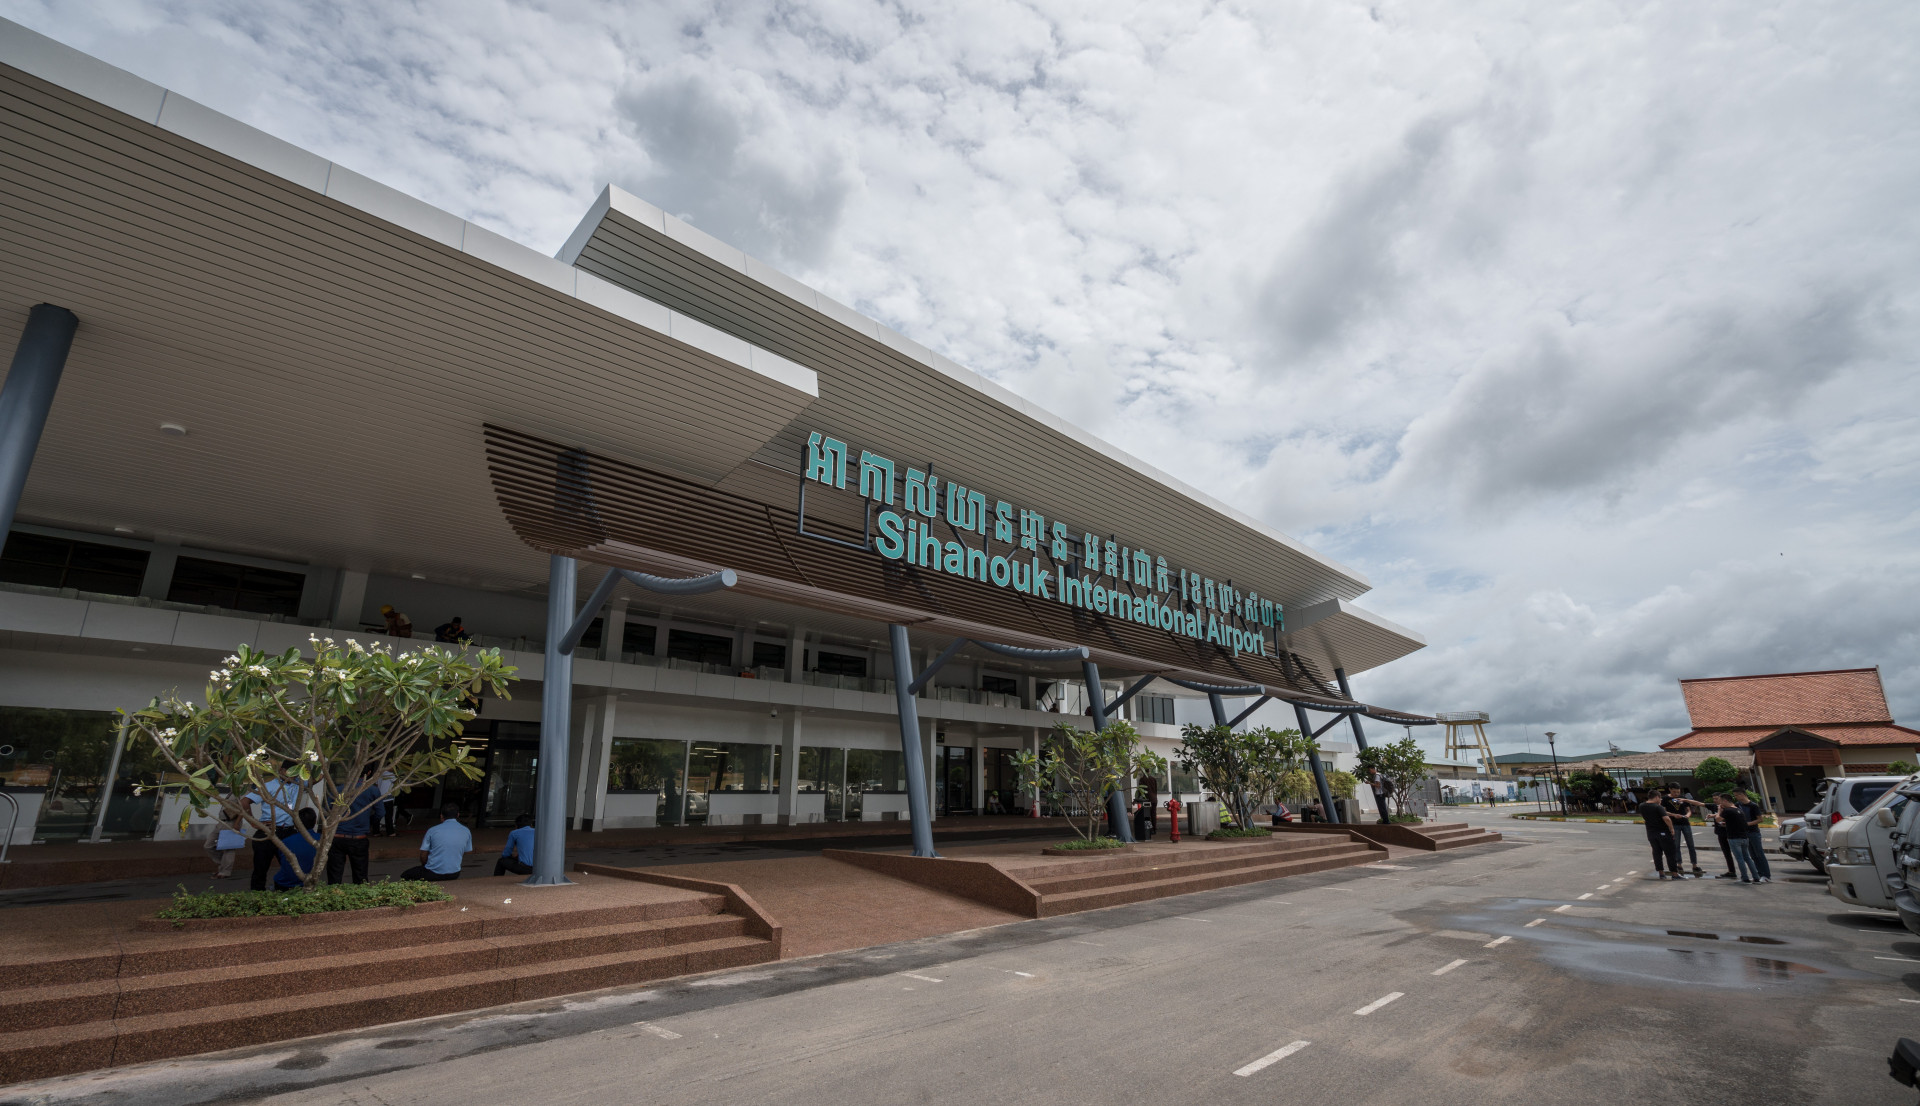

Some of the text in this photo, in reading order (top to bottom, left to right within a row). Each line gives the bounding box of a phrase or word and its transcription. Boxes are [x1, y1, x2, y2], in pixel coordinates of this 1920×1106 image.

[874, 510, 1266, 658] Sihanouk International Airport
